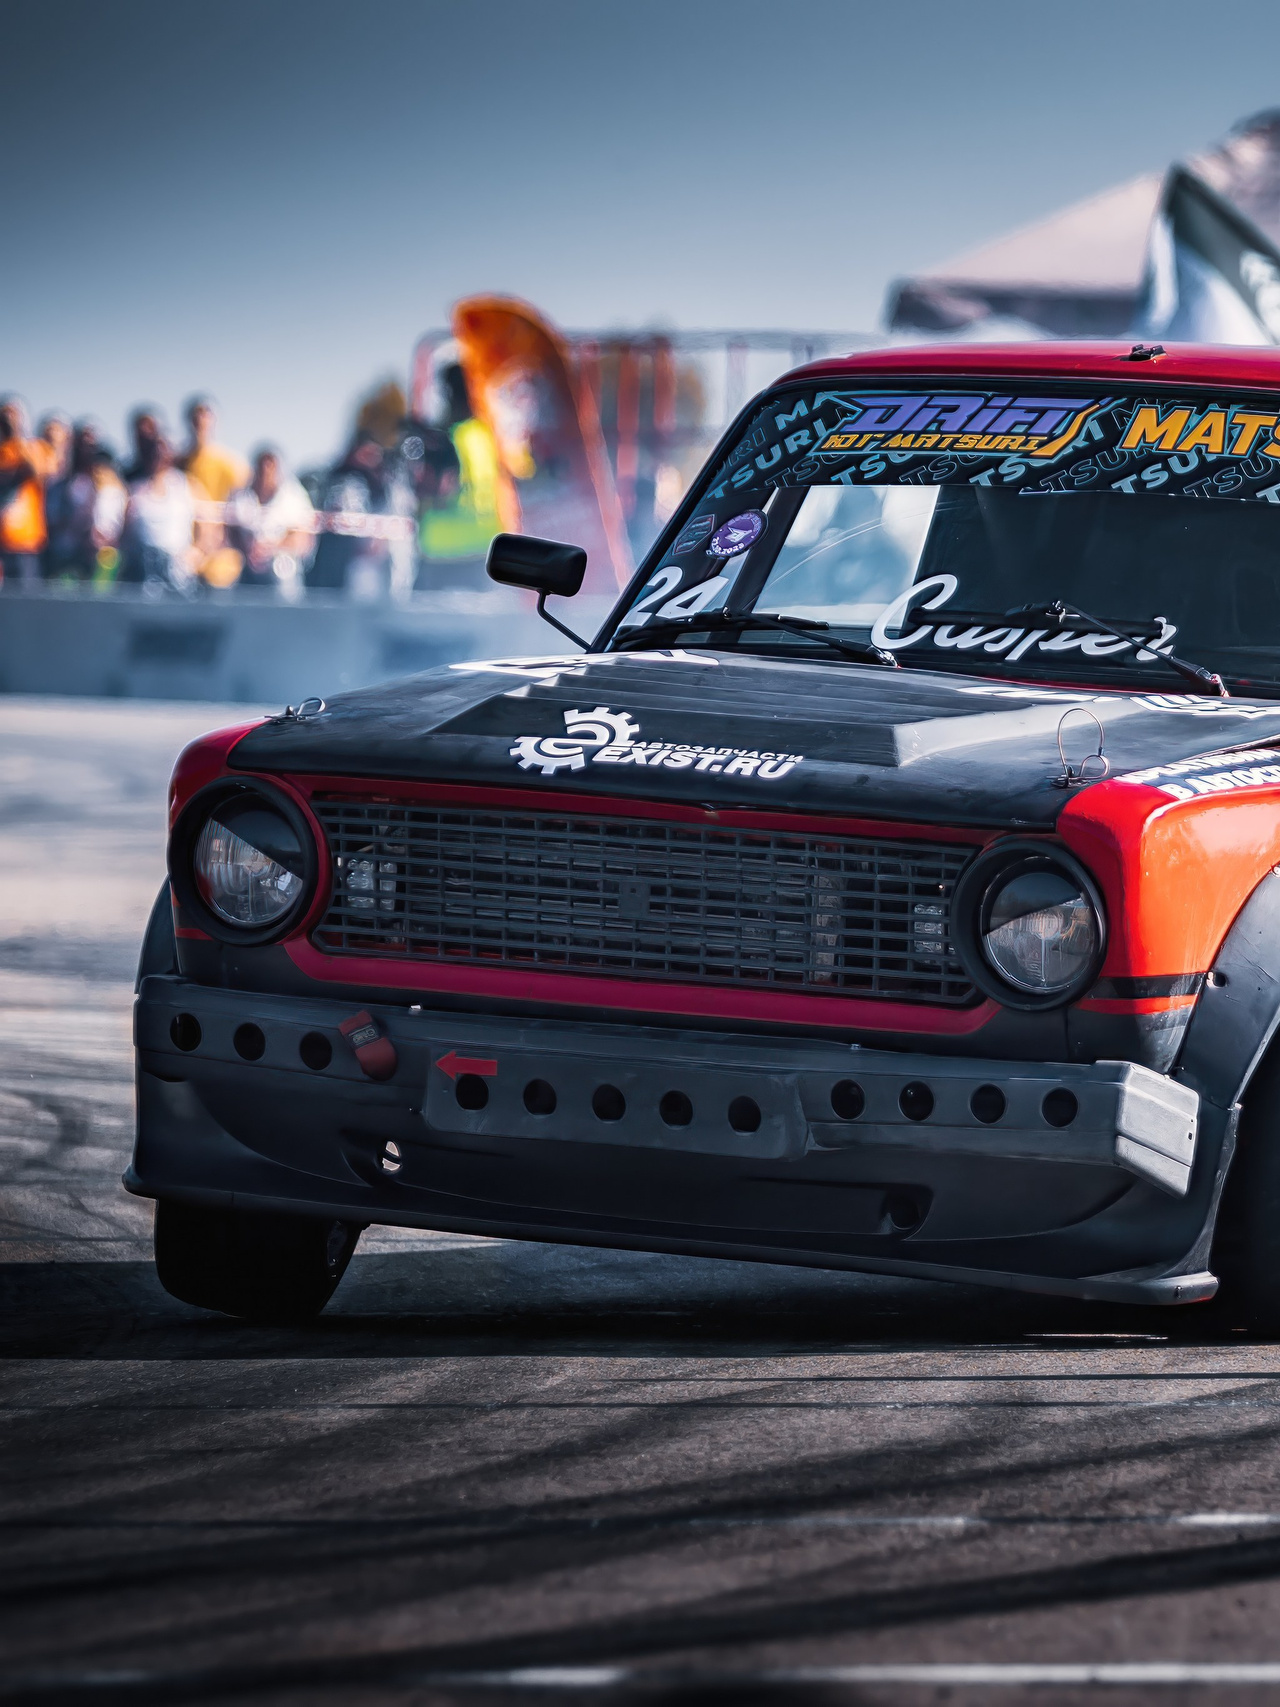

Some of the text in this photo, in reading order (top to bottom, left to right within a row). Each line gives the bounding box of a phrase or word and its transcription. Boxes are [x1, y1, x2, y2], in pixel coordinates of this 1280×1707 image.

[840, 396, 1097, 434] DRIFT
[617, 565, 730, 628] 24
[592, 745, 798, 780] EXIST.RU
[631, 741, 804, 763] АВТОЗАПЧАСТИ
